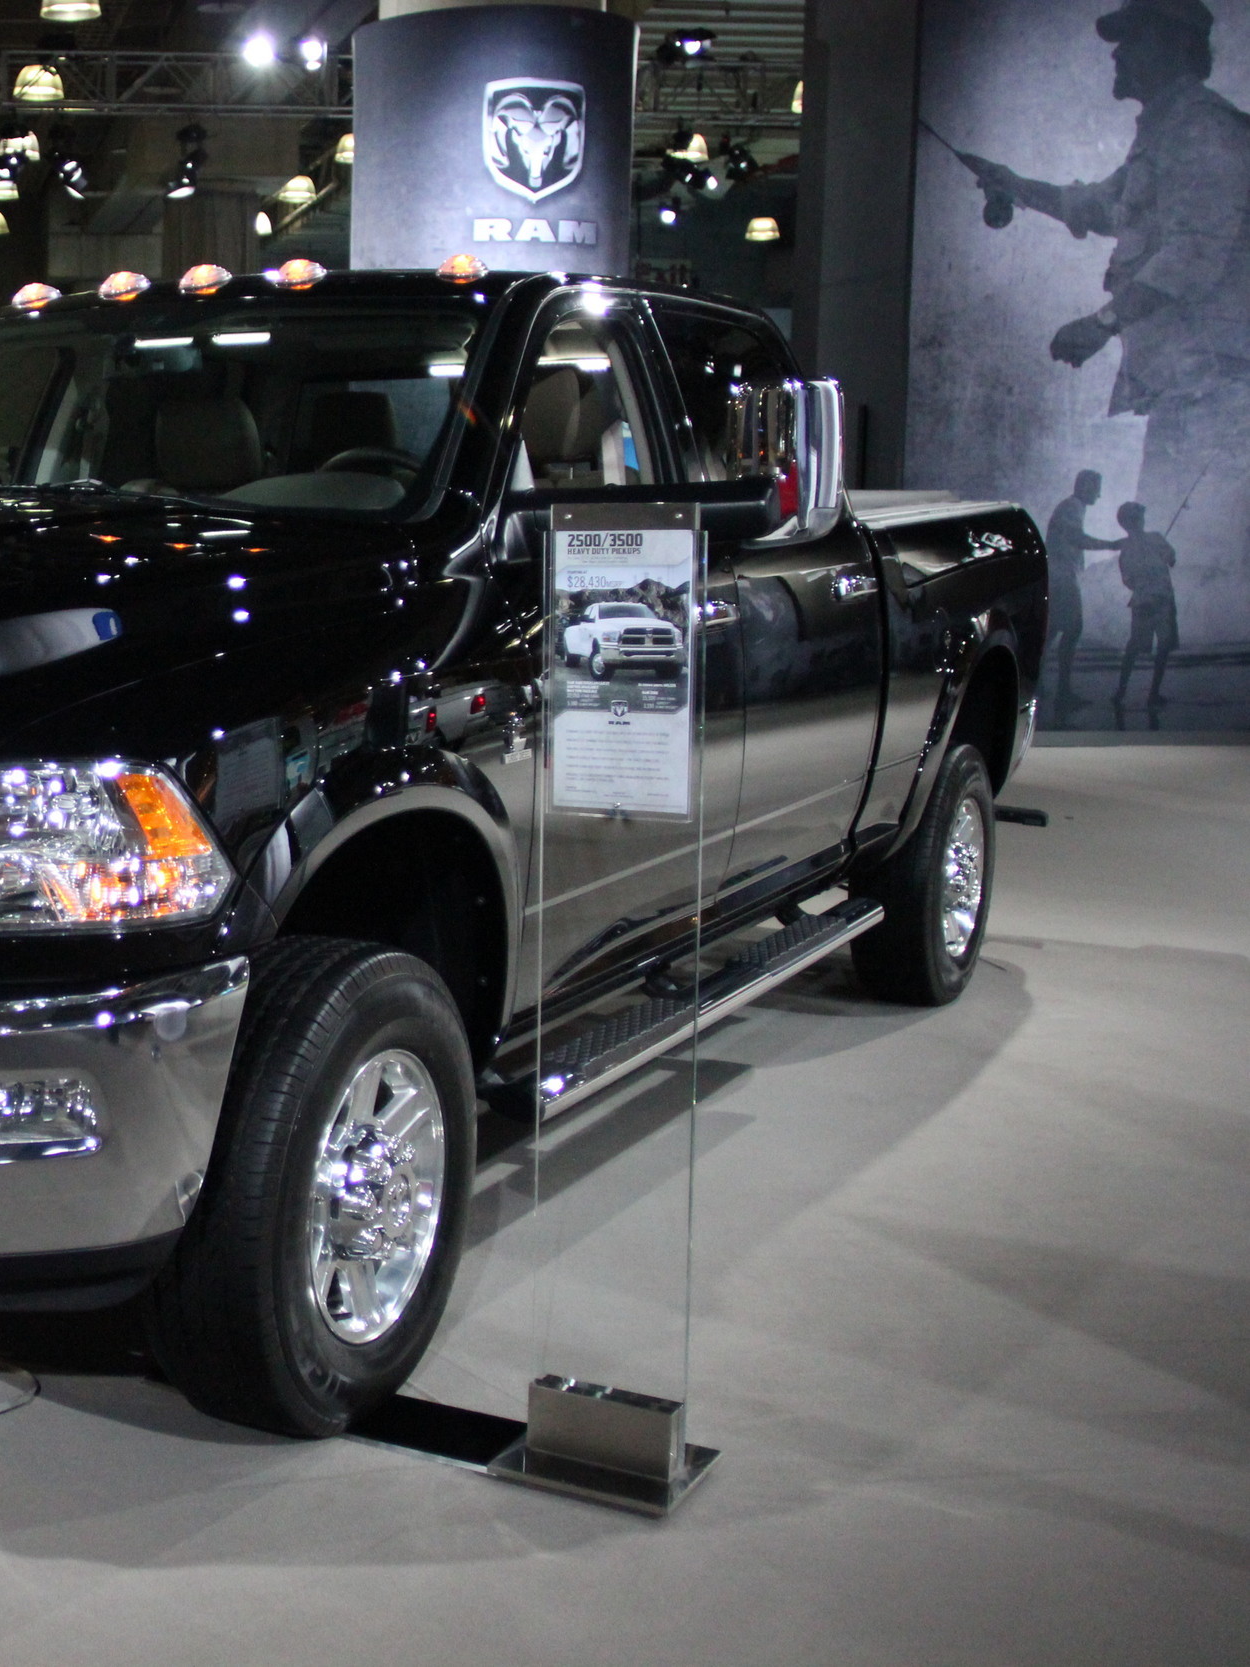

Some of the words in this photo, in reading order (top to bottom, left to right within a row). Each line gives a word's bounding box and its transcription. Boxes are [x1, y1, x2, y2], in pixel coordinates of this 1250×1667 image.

[472, 218, 598, 245] RAM
[567, 532, 644, 547] 2500/3500
[611, 547, 642, 555] PICKUPS
